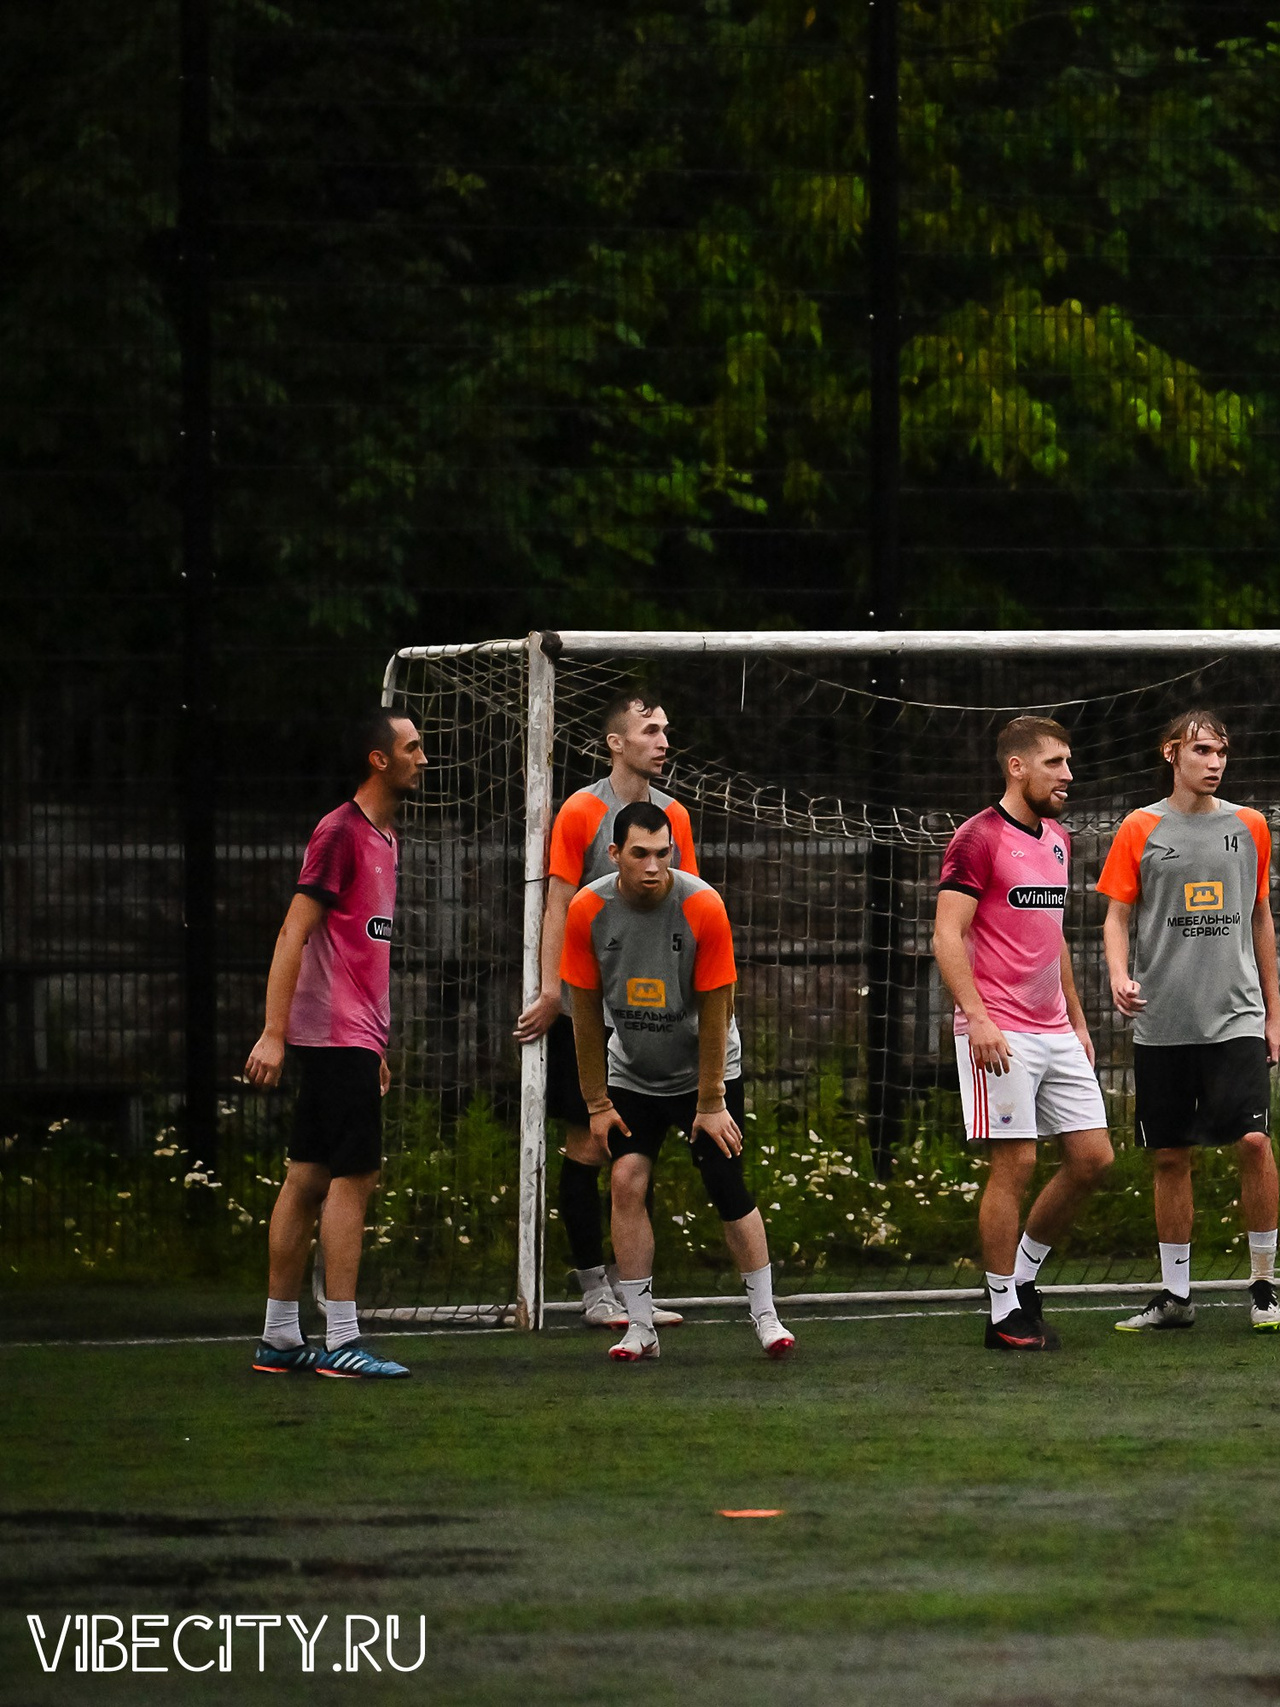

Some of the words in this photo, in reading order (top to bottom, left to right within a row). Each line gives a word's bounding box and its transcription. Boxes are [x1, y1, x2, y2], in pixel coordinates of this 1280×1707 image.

[1223, 834, 1239, 853] 14
[1016, 890, 1063, 906] Winline
[1167, 912, 1240, 927] МЕБЕЛЬНЫЙ
[1182, 925, 1230, 938] СЕРВИС
[672, 933, 682, 952] 5
[624, 1021, 674, 1033] СЕРВИС
